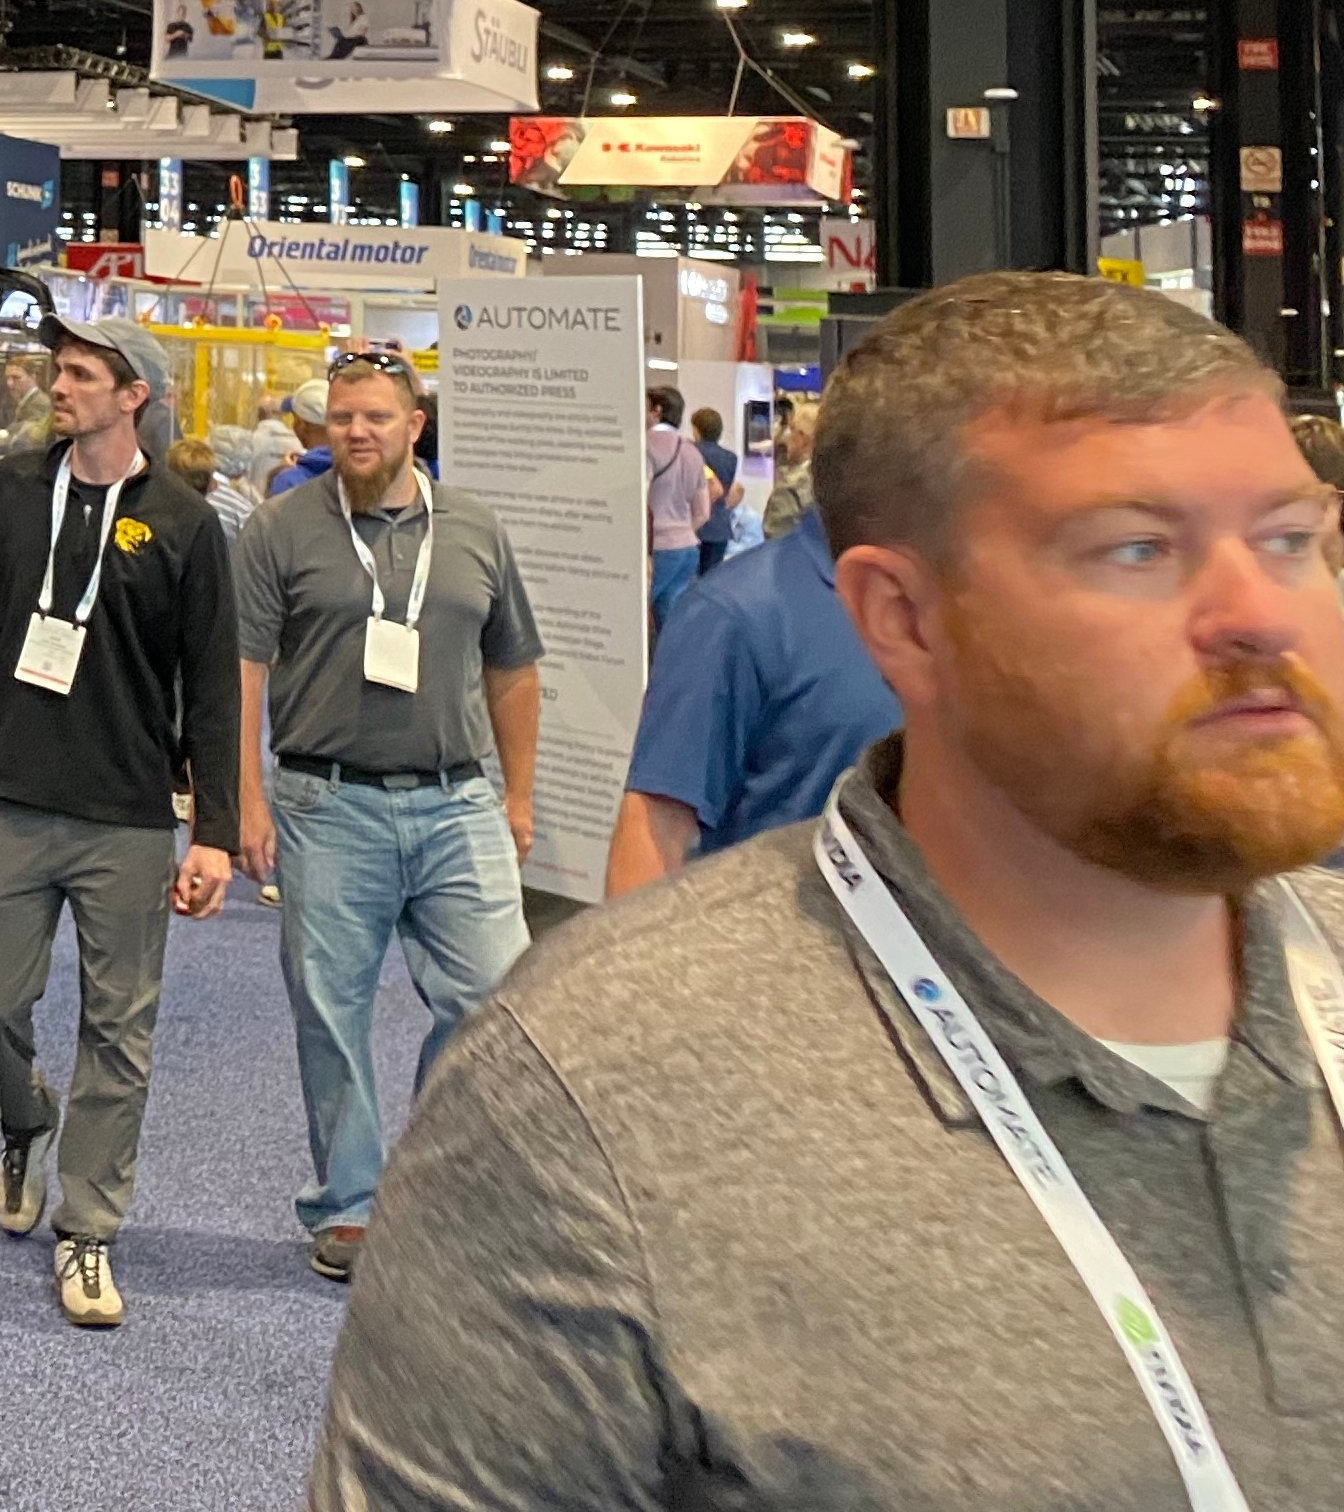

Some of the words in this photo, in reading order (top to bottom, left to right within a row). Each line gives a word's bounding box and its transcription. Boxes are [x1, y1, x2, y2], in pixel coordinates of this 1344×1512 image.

[477, 306, 621, 332] AUTOMATE
[453, 366, 529, 379] VIDEOGRAPHY
[532, 368, 542, 380] IS
[544, 369, 589, 383] LIMITED
[453, 382, 468, 393] TO
[470, 383, 538, 398] AUTHORIZED
[541, 386, 576, 399] PRESS
